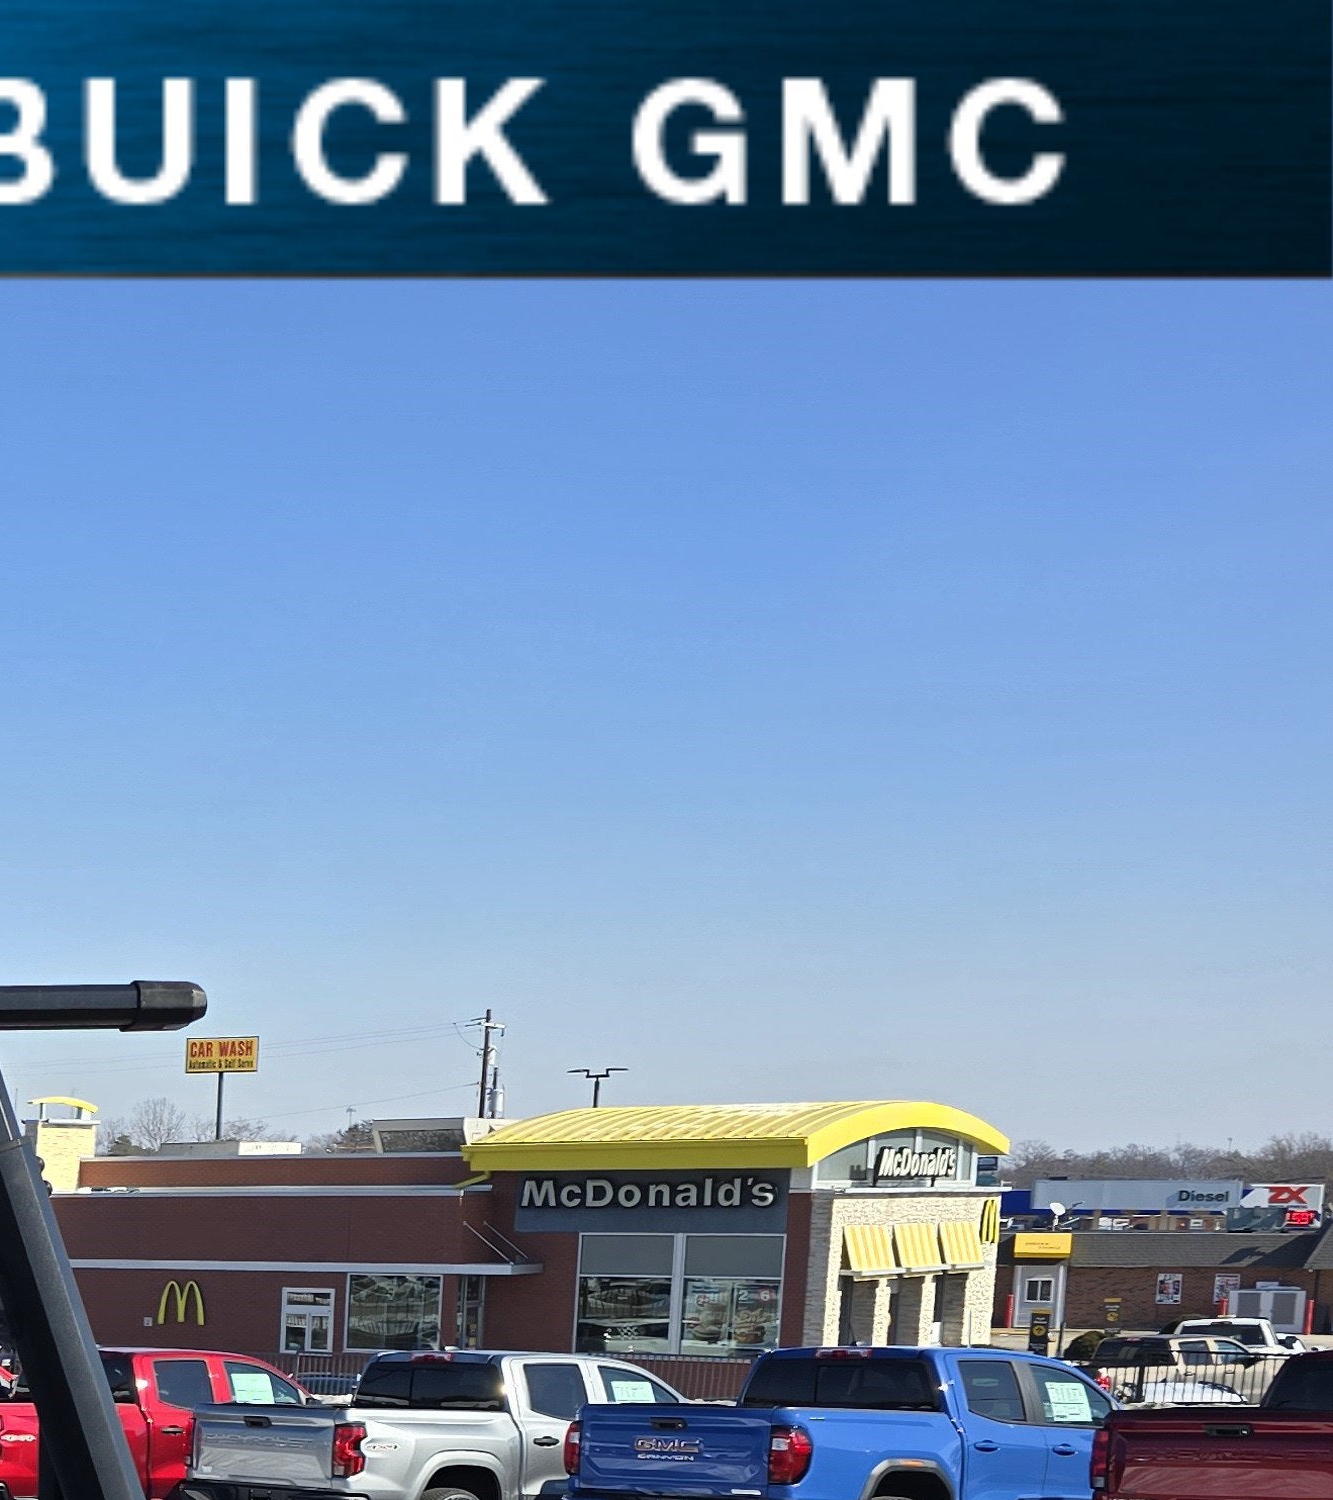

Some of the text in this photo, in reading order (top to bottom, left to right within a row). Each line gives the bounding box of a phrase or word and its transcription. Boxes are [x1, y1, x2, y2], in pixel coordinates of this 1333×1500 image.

[190, 1040, 254, 1058] CAR WASH
[879, 1147, 957, 1178] McDonald's
[520, 1178, 776, 1207] McDonald's
[1178, 1190, 1229, 1202] Diesel
[635, 1436, 700, 1453] GMC
